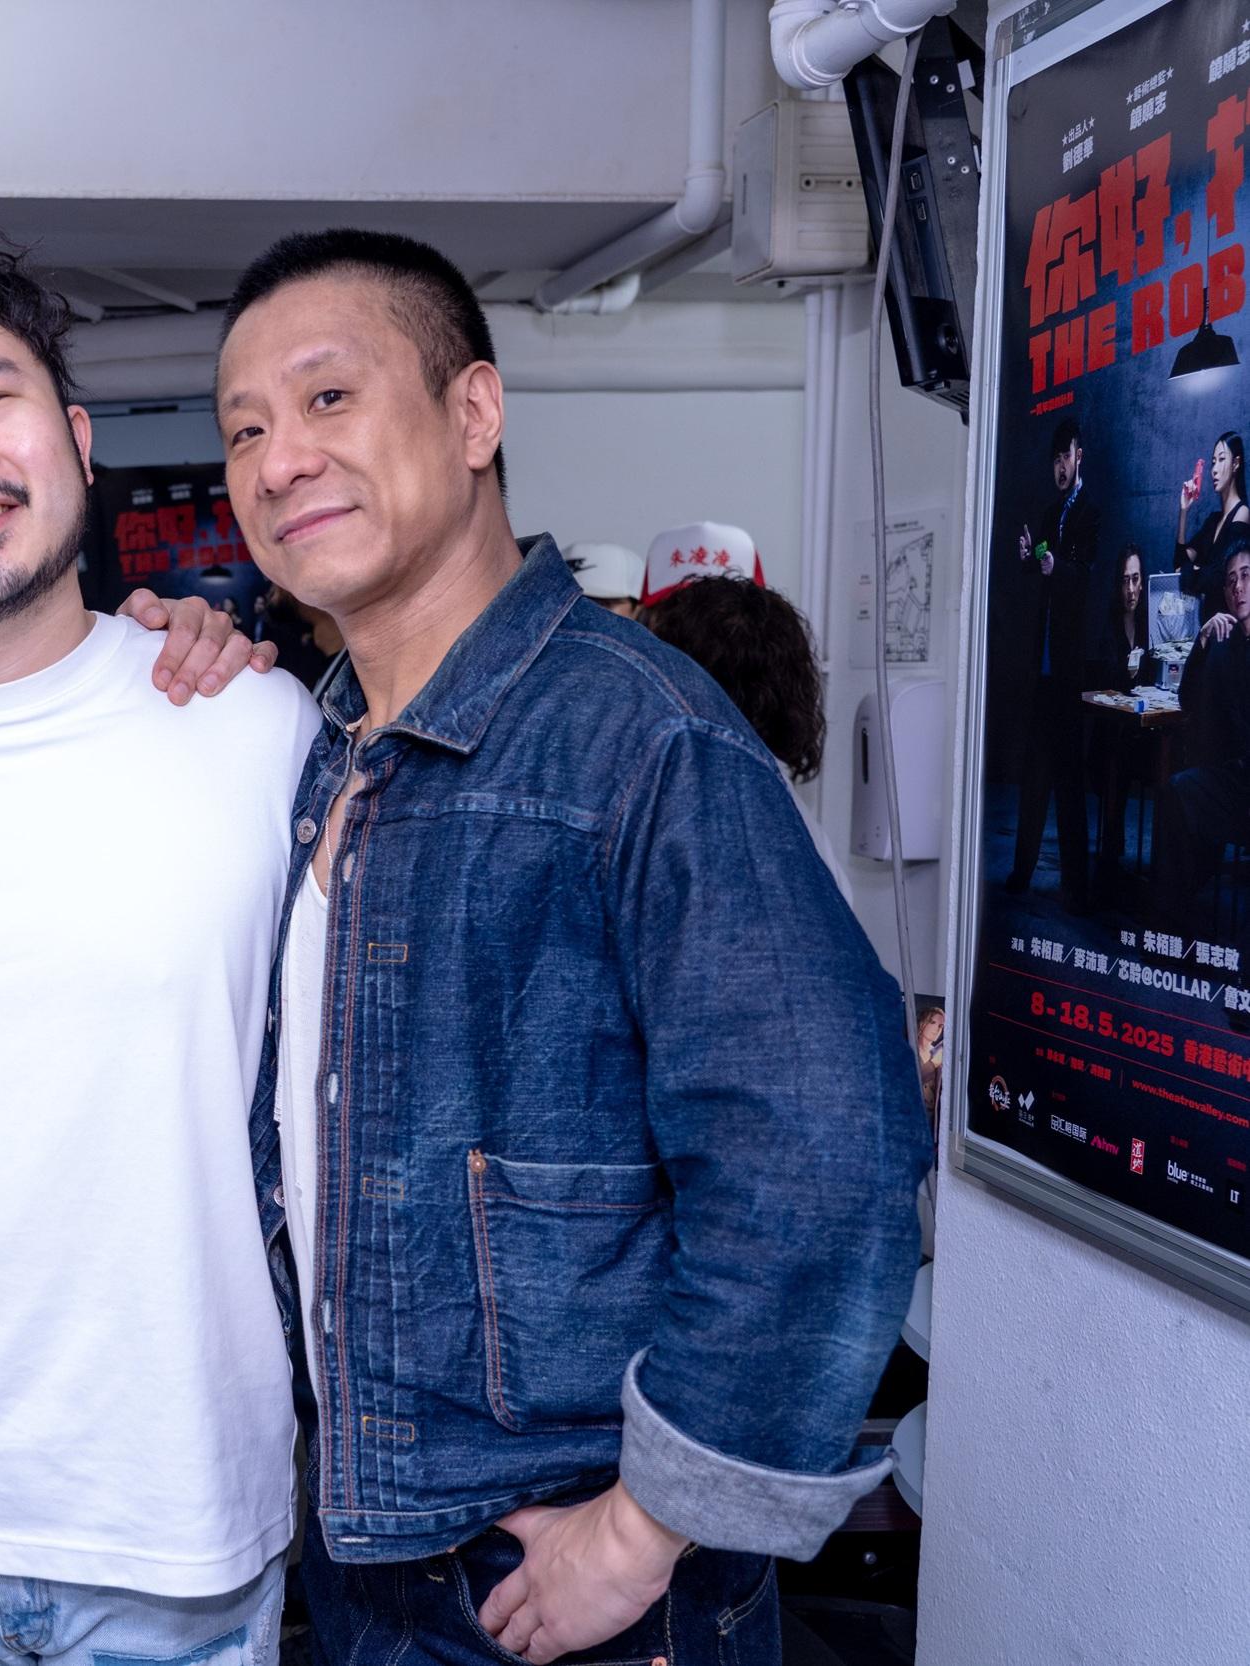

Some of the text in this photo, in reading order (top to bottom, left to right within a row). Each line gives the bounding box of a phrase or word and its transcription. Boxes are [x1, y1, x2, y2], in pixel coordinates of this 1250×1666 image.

[1029, 243, 1246, 394] THE ROB
[1168, 1160, 1189, 1182] blue
